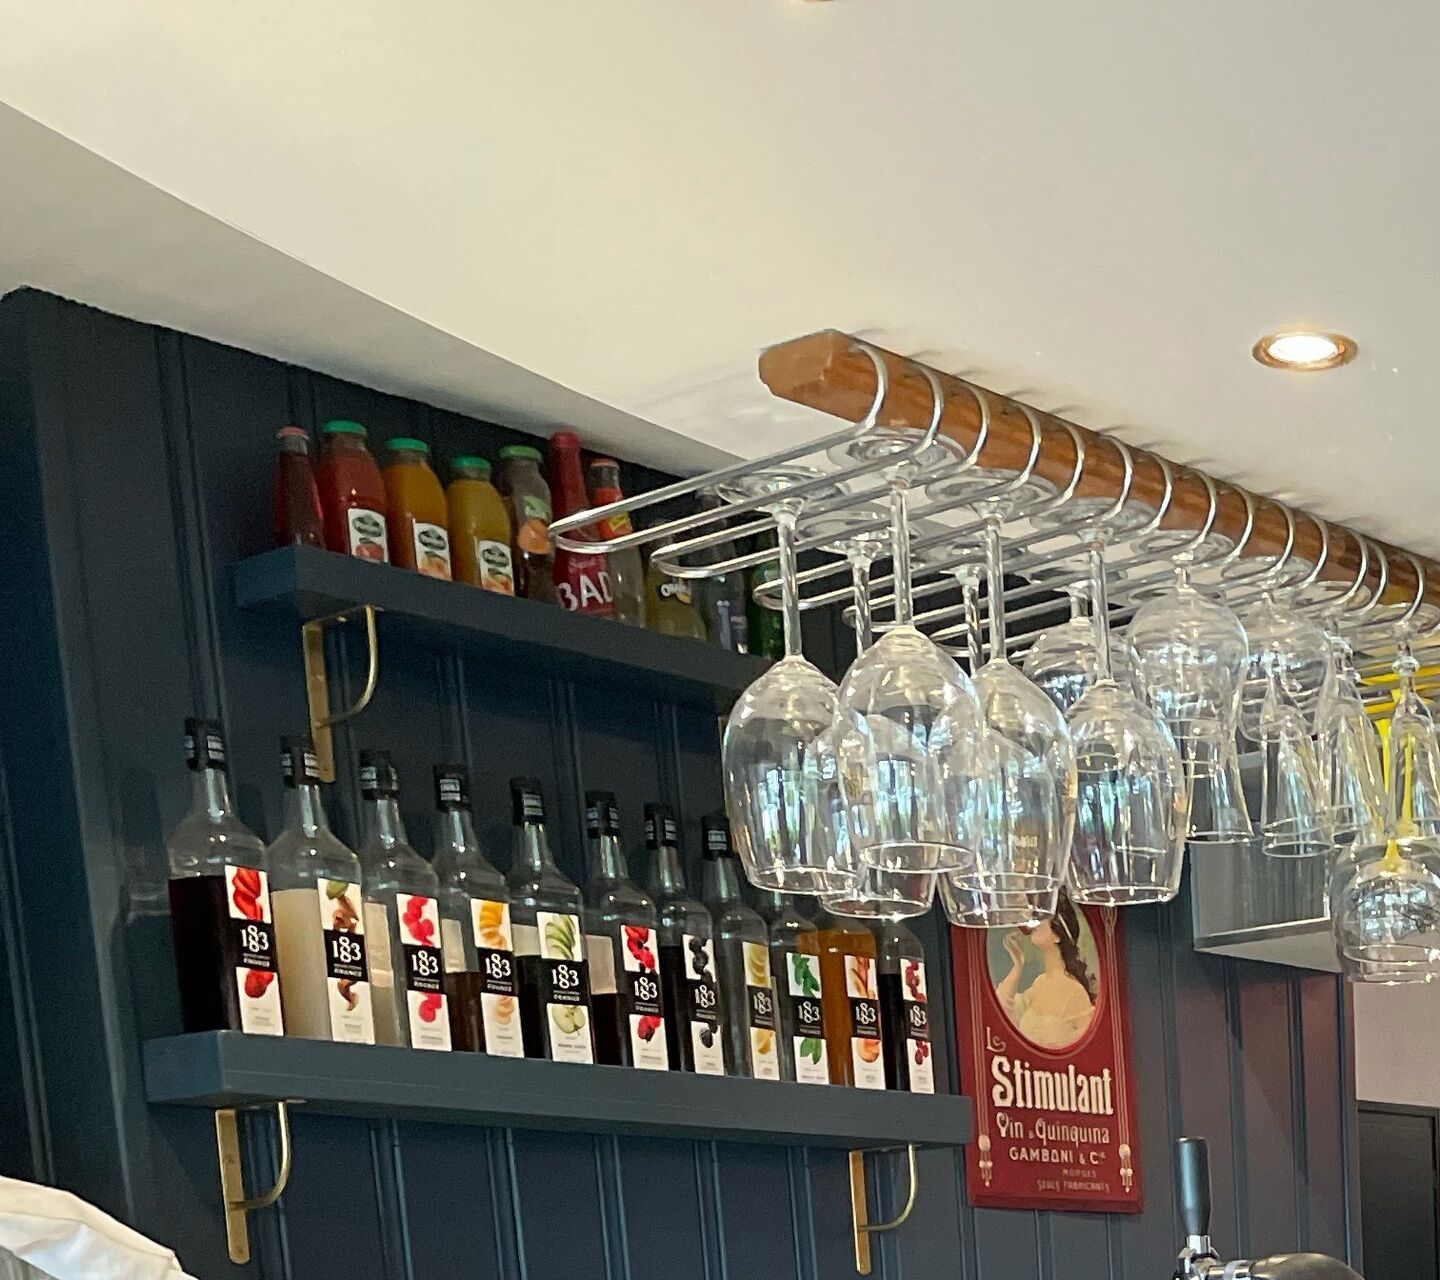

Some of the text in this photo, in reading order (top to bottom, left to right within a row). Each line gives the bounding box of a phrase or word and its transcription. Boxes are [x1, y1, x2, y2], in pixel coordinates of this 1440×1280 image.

[991, 1055, 1114, 1115] Stimulant
[996, 1112, 1110, 1148] Vin Quinquina
[1009, 1146, 1074, 1164] GAMBONI
